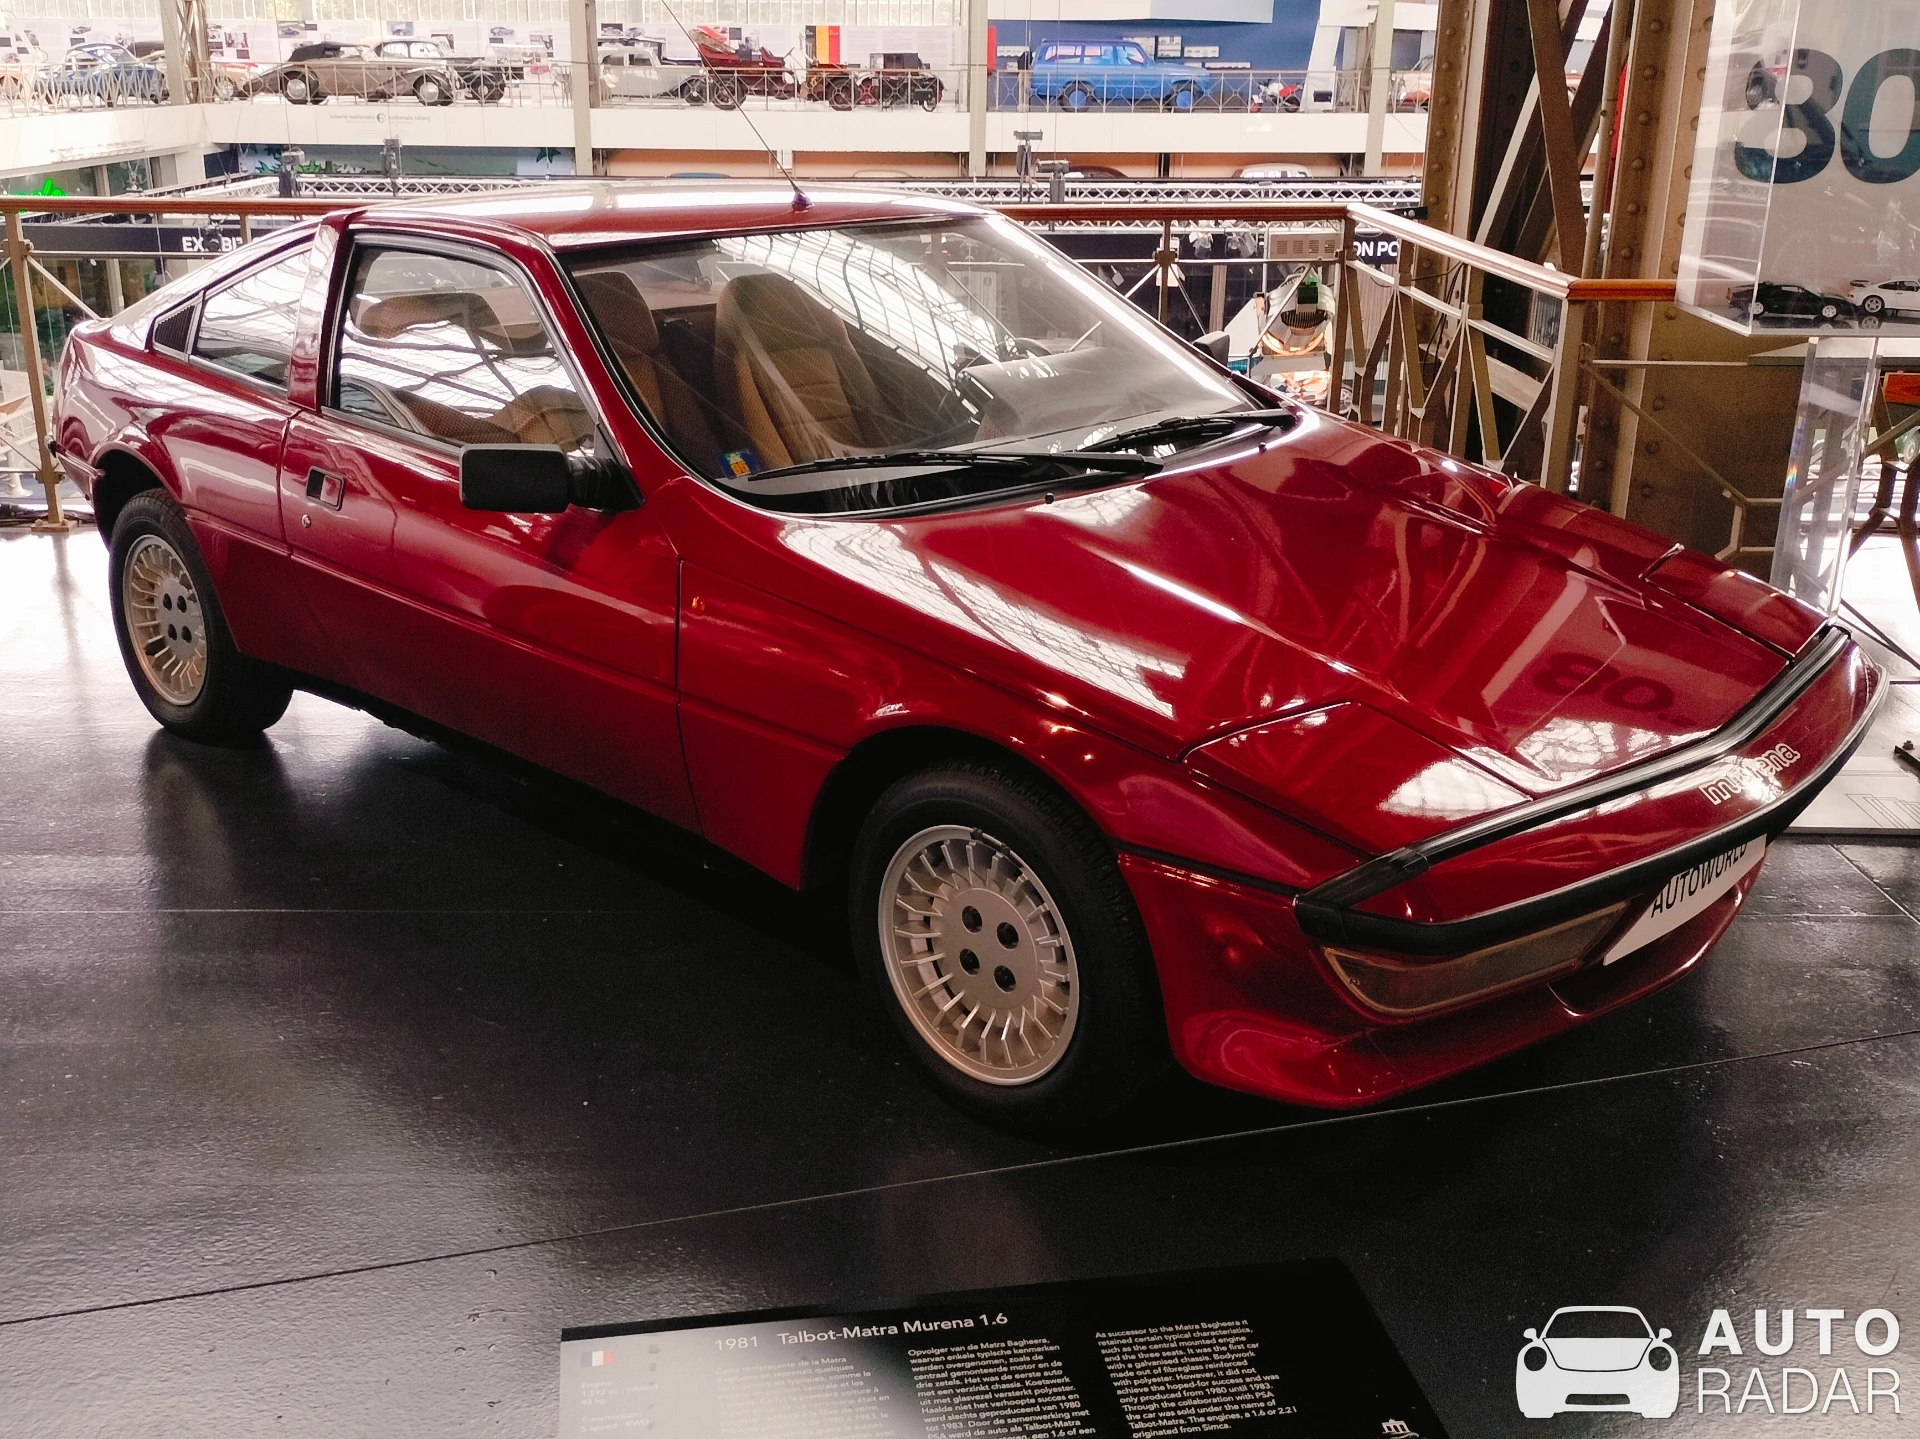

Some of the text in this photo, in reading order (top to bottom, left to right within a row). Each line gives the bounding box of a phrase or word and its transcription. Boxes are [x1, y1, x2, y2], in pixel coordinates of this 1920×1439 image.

[1734, 48, 1920, 184] 80
[715, 1313, 1008, 1351] 1981 Talbot-Matra Murena 1.6
[1108, 1329, 1146, 1337] successor
[1201, 1321, 1240, 1329] Bagheera
[1098, 1337, 1132, 1346] retained
[1164, 1332, 1191, 1341] typical
[1101, 1346, 1120, 1354] such
[1149, 1341, 1177, 1349] central
[1179, 1337, 1216, 1346] mounted
[1218, 1336, 1246, 1344] engine
[908, 1347, 948, 1356] Opvolger
[910, 1345, 1060, 1364] waarvan enkele typische kenmerken
[1104, 1354, 1120, 1362] and
[1135, 1357, 1179, 1368] galvanised
[1213, 1350, 1255, 1360] Bodywork
[911, 1364, 944, 1372] werden
[914, 1371, 948, 1380] centraal
[950, 1366, 1008, 1378] gemonteerde
[1110, 1370, 1134, 1378] made
[1163, 1364, 1204, 1373] fibreglass
[1205, 1359, 1248, 1369] reinforced
[955, 1384, 990, 1393] verzinkt
[1025, 1376, 1070, 1386] Koetswerk
[1166, 1380, 1209, 1390] hoped-for
[953, 1392, 992, 1403] glasvezel
[994, 1389, 1032, 1398] versterkt
[1140, 1391, 1182, 1402] produced
[921, 1406, 952, 1414] Haalde
[990, 1398, 1035, 1407] verhoopte
[1122, 1402, 1160, 1411] Through
[1178, 1396, 1234, 1406] collaboration
[1177, 1407, 1195, 1415] sold
[1197, 1405, 1222, 1413] under
[923, 1414, 946, 1422] werd
[947, 1412, 977, 1420] slechts
[979, 1405, 1040, 1418] geproduceerd
[1059, 1401, 1081, 1409] 1980
[1007, 1412, 1070, 1423] samenwerking
[948, 1430, 971, 1438] werd
[1024, 1420, 1081, 1430] Talbot-Matra
[1067, 1428, 1077, 1436] of
[1079, 1427, 1096, 1435] een
[1133, 1427, 1178, 1438] originated
